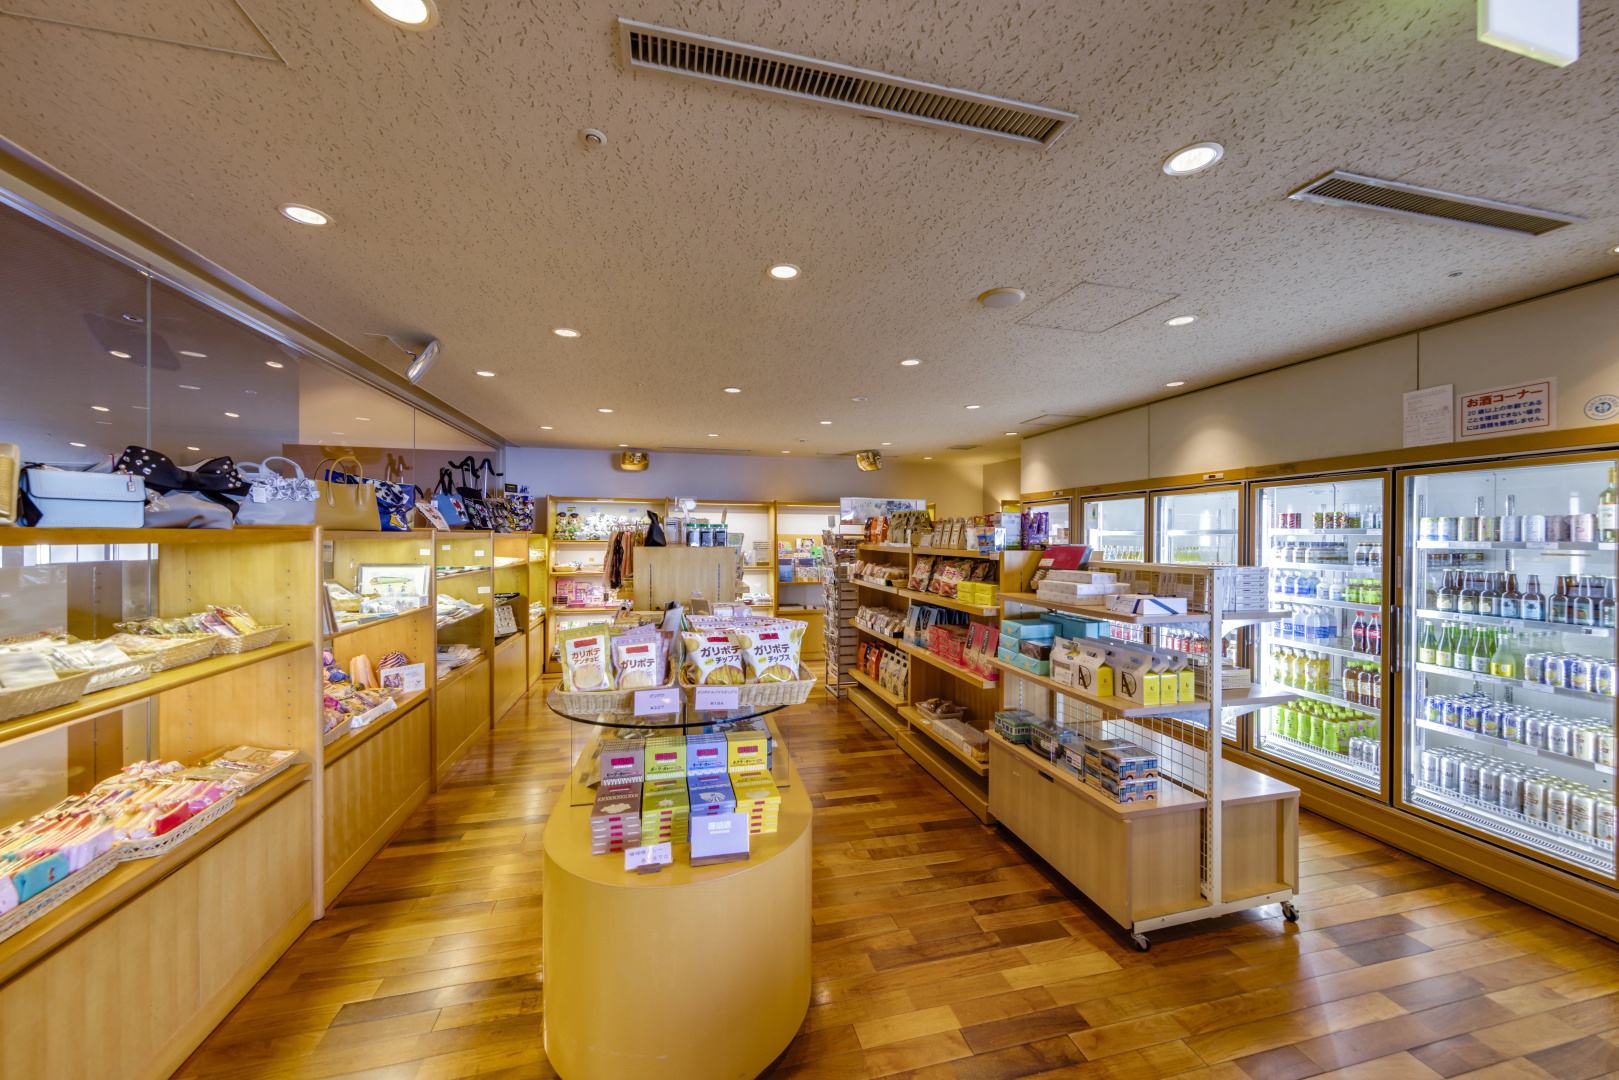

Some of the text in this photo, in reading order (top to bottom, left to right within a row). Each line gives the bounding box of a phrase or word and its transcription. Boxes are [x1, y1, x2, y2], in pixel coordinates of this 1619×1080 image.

[1467, 389, 1543, 408] お酒コーナー
[571, 648, 601, 660] ガリポテ
[701, 645, 741, 657] ガリポテ
[753, 643, 790, 656] ガリポテ
[573, 656, 599, 665] アンチョビ
[620, 658, 655, 669] ガリポテ
[716, 655, 741, 664] チップス
[768, 654, 791, 663] チップス
